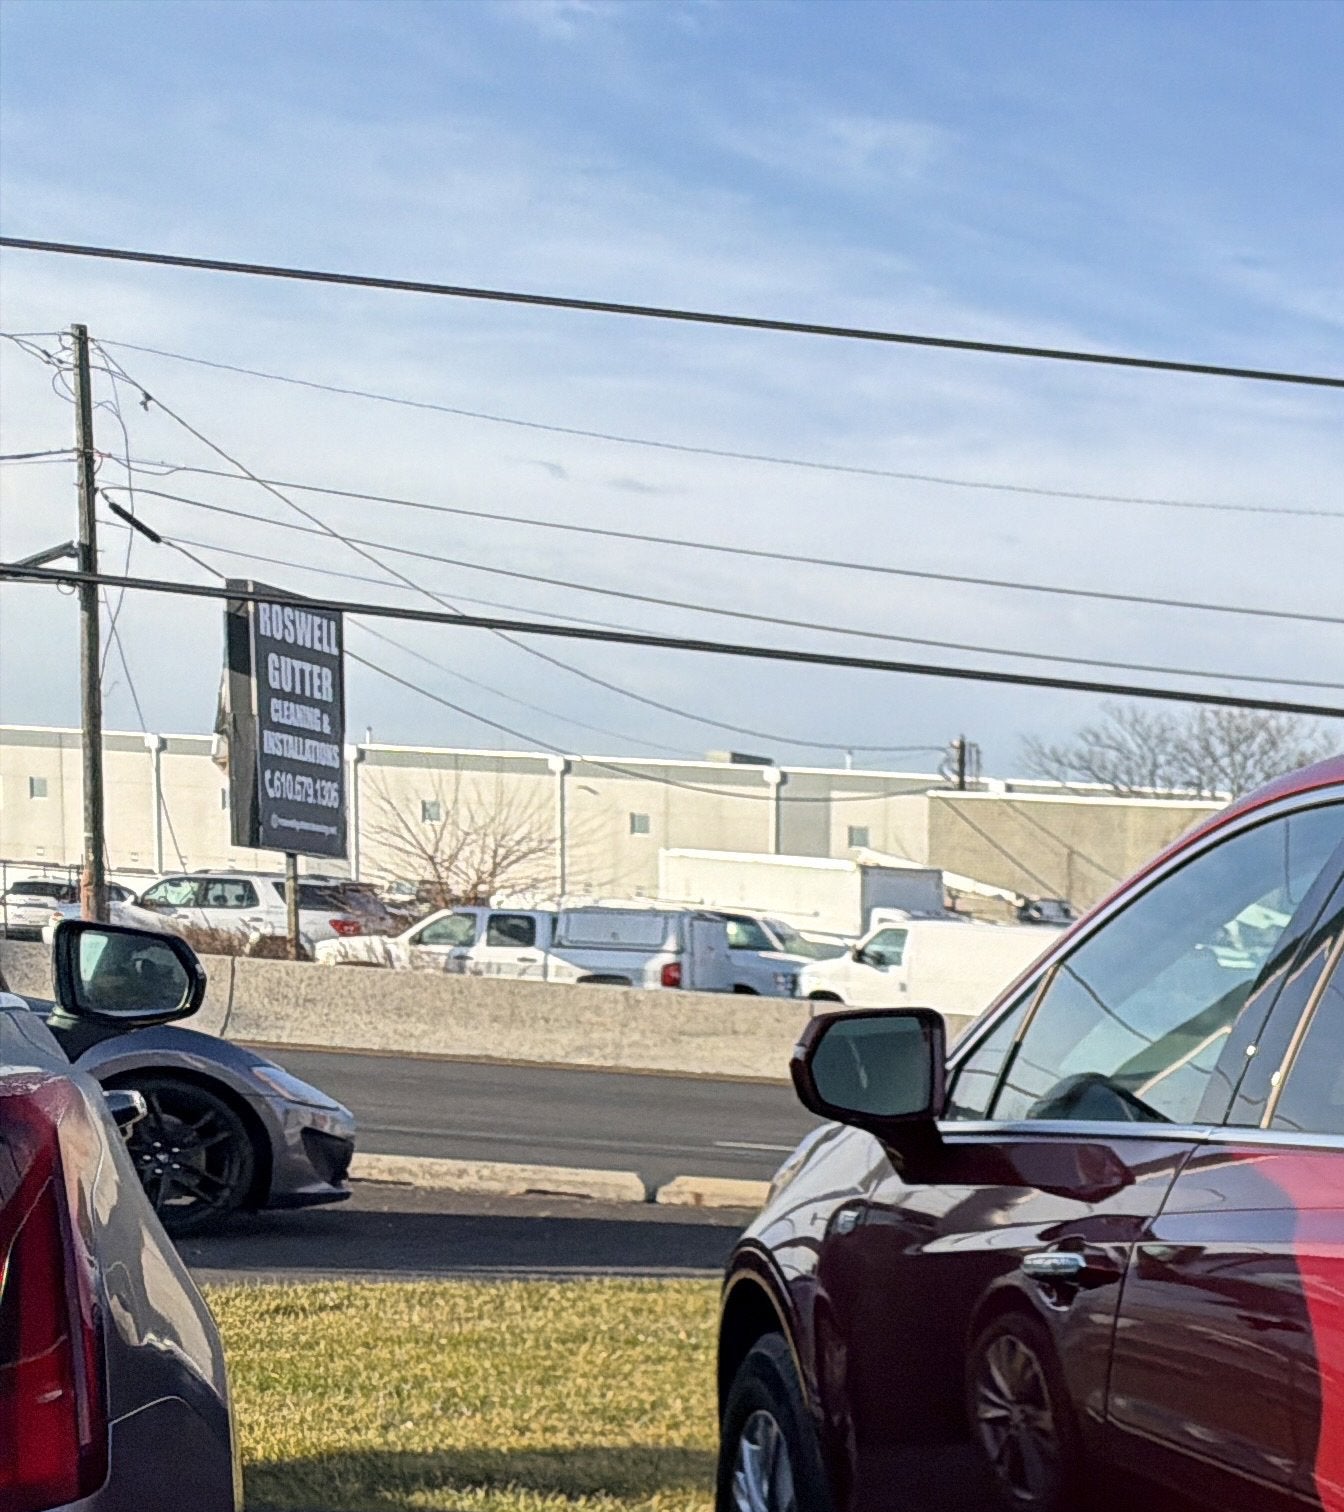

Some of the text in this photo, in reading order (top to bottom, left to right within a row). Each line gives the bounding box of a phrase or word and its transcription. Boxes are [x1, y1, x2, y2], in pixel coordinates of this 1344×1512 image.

[258, 602, 339, 656] ROSWELL
[267, 652, 333, 702] GUTTER
[270, 698, 331, 735] CLEANING &
[262, 730, 339, 768] INSTALLATIONS
